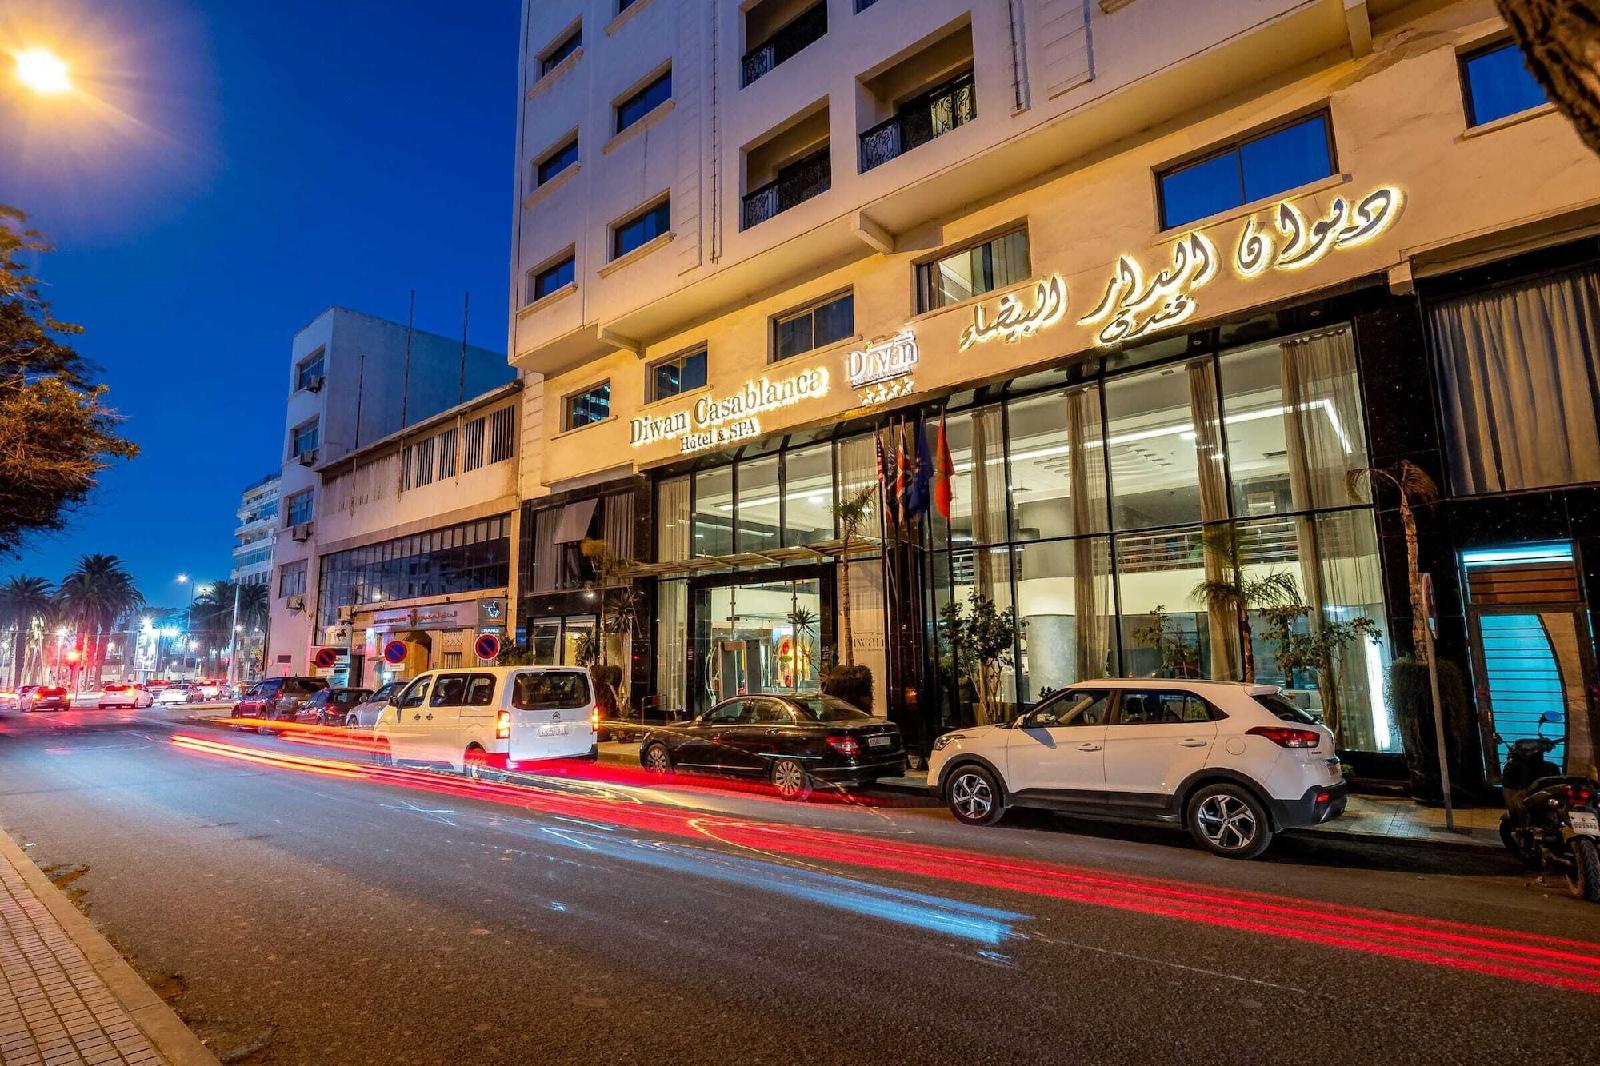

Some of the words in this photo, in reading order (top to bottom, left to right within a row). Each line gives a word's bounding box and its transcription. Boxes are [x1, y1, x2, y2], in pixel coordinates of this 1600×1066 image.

[1237, 188, 1397, 271] ديوان
[1080, 232, 1213, 321] الدار
[1099, 293, 1196, 343] فندق
[629, 410, 688, 444] Diwan
[693, 368, 828, 425] Casablanca
[716, 427, 726, 442] &
[729, 417, 757, 438] SPA
